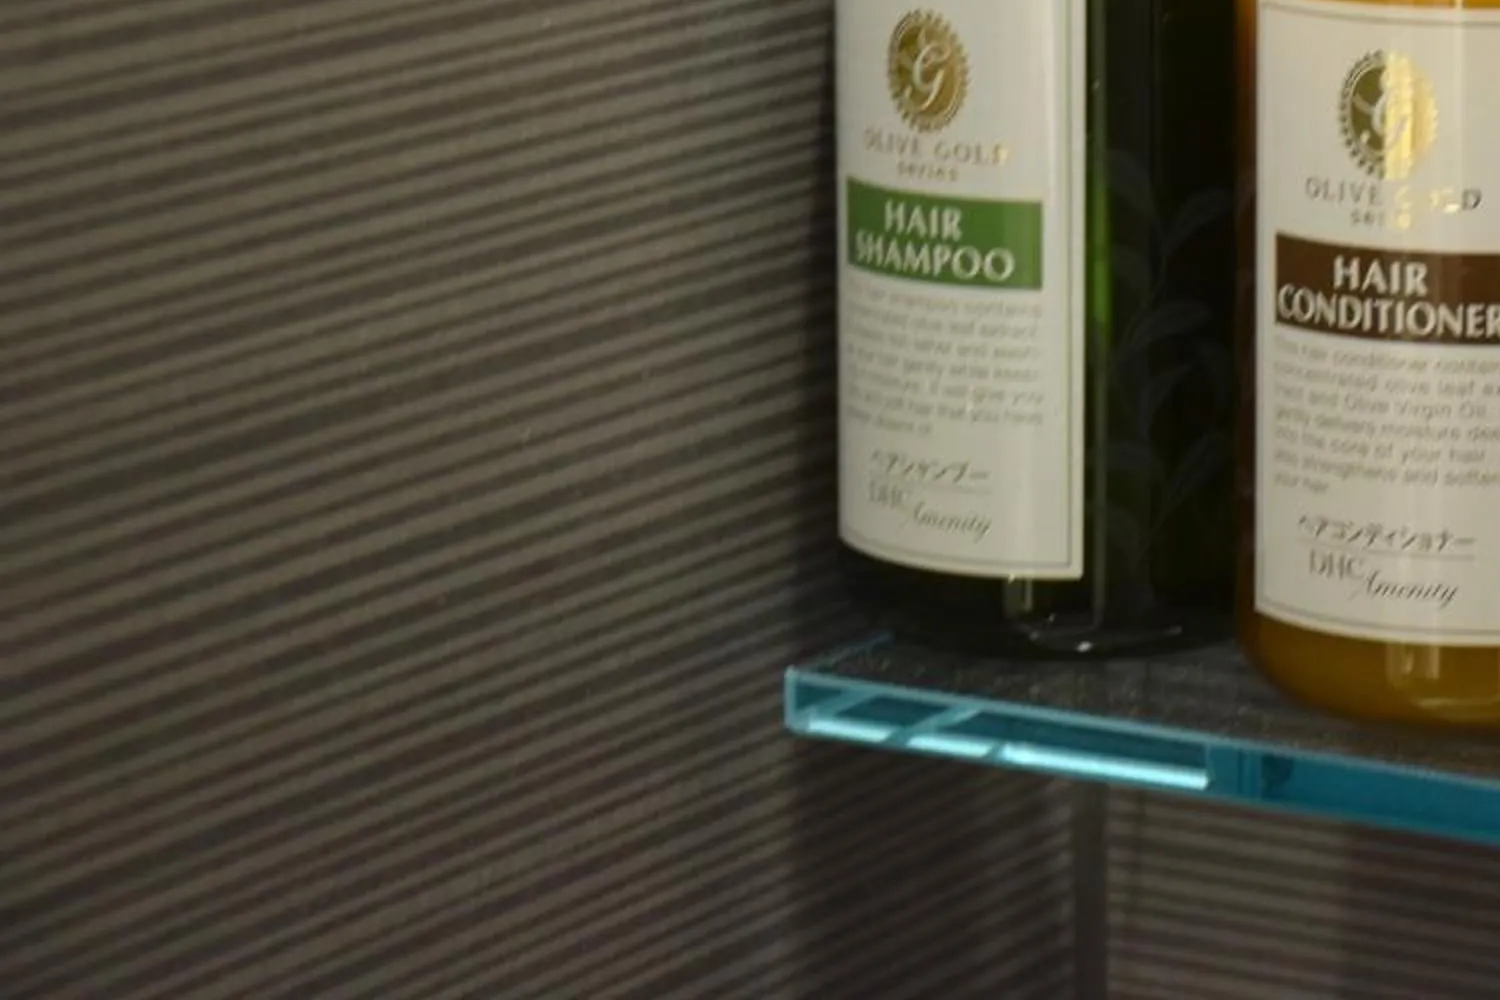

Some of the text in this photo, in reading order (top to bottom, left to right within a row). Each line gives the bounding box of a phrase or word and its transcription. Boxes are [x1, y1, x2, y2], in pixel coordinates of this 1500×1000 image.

[1305, 177, 1382, 205] OLIVE
[884, 200, 963, 243] HAIR
[856, 229, 1015, 281] SHAMPOO
[1333, 254, 1428, 297] HAIR
[1298, 514, 1478, 553] ヘアコンディショナー
[1308, 547, 1460, 611] DHC Amenity
